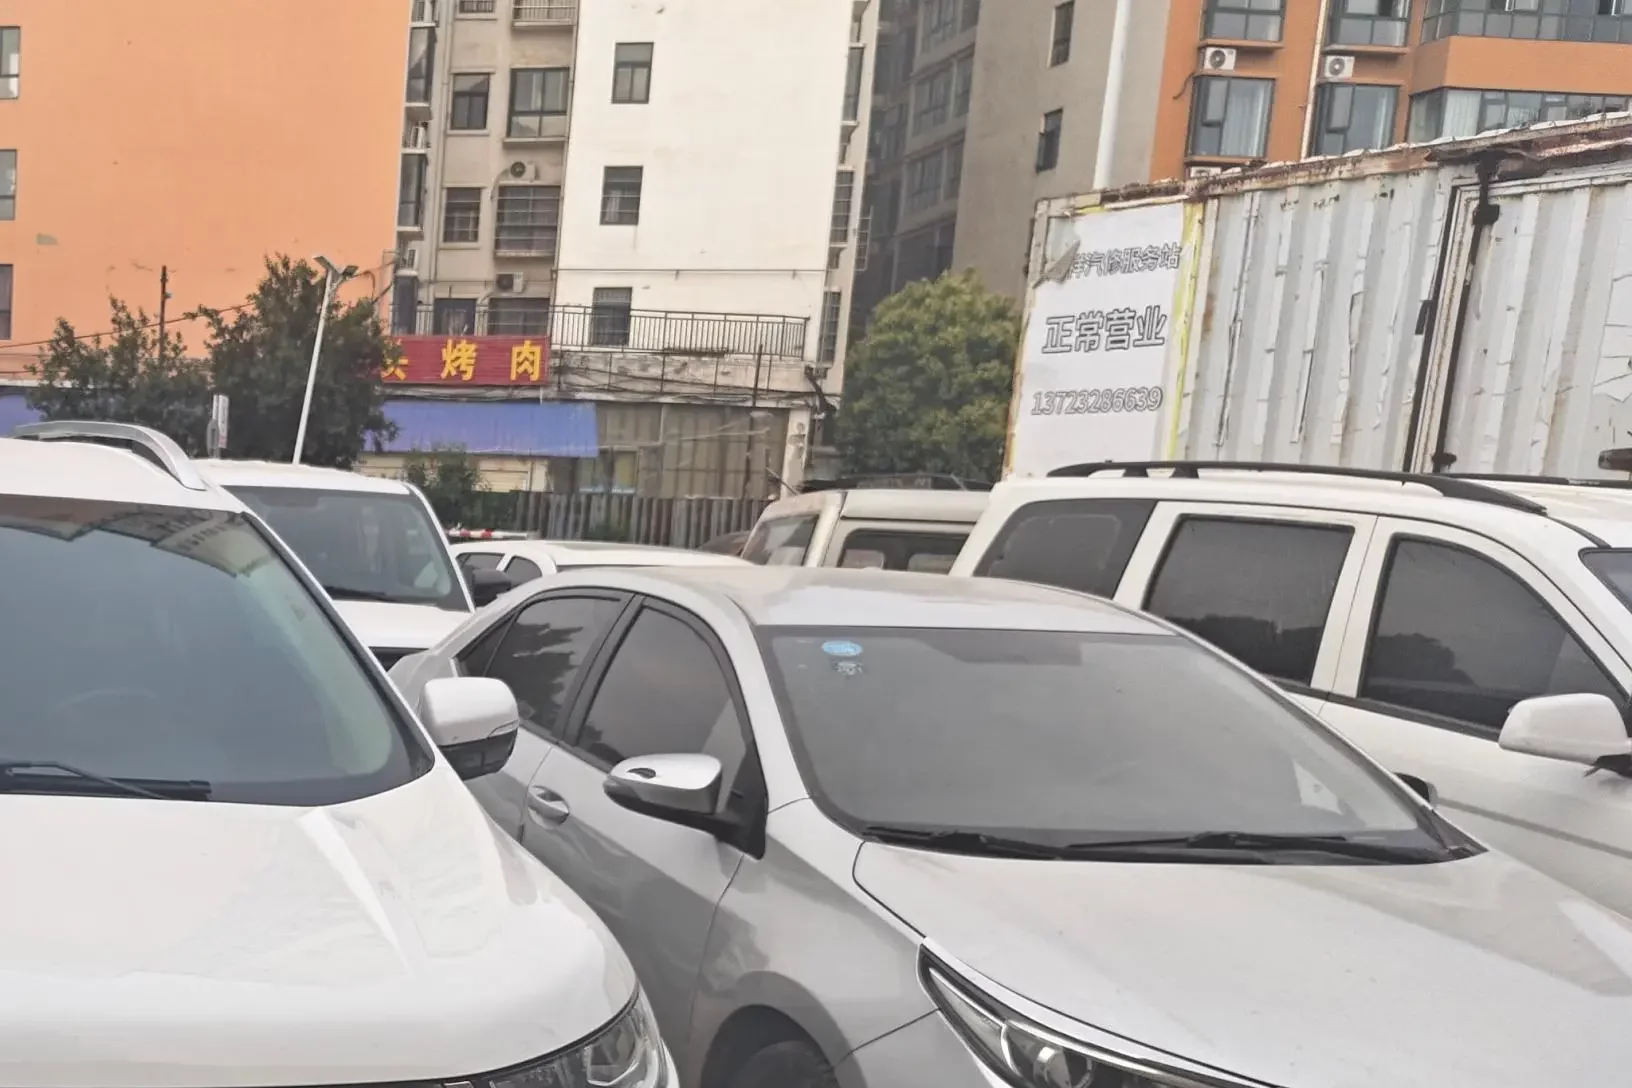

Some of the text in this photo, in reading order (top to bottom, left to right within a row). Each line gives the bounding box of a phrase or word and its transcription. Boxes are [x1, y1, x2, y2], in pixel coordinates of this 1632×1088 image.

[1041, 305, 1167, 354] 正常营业
[1031, 386, 1163, 415] 13723286639
